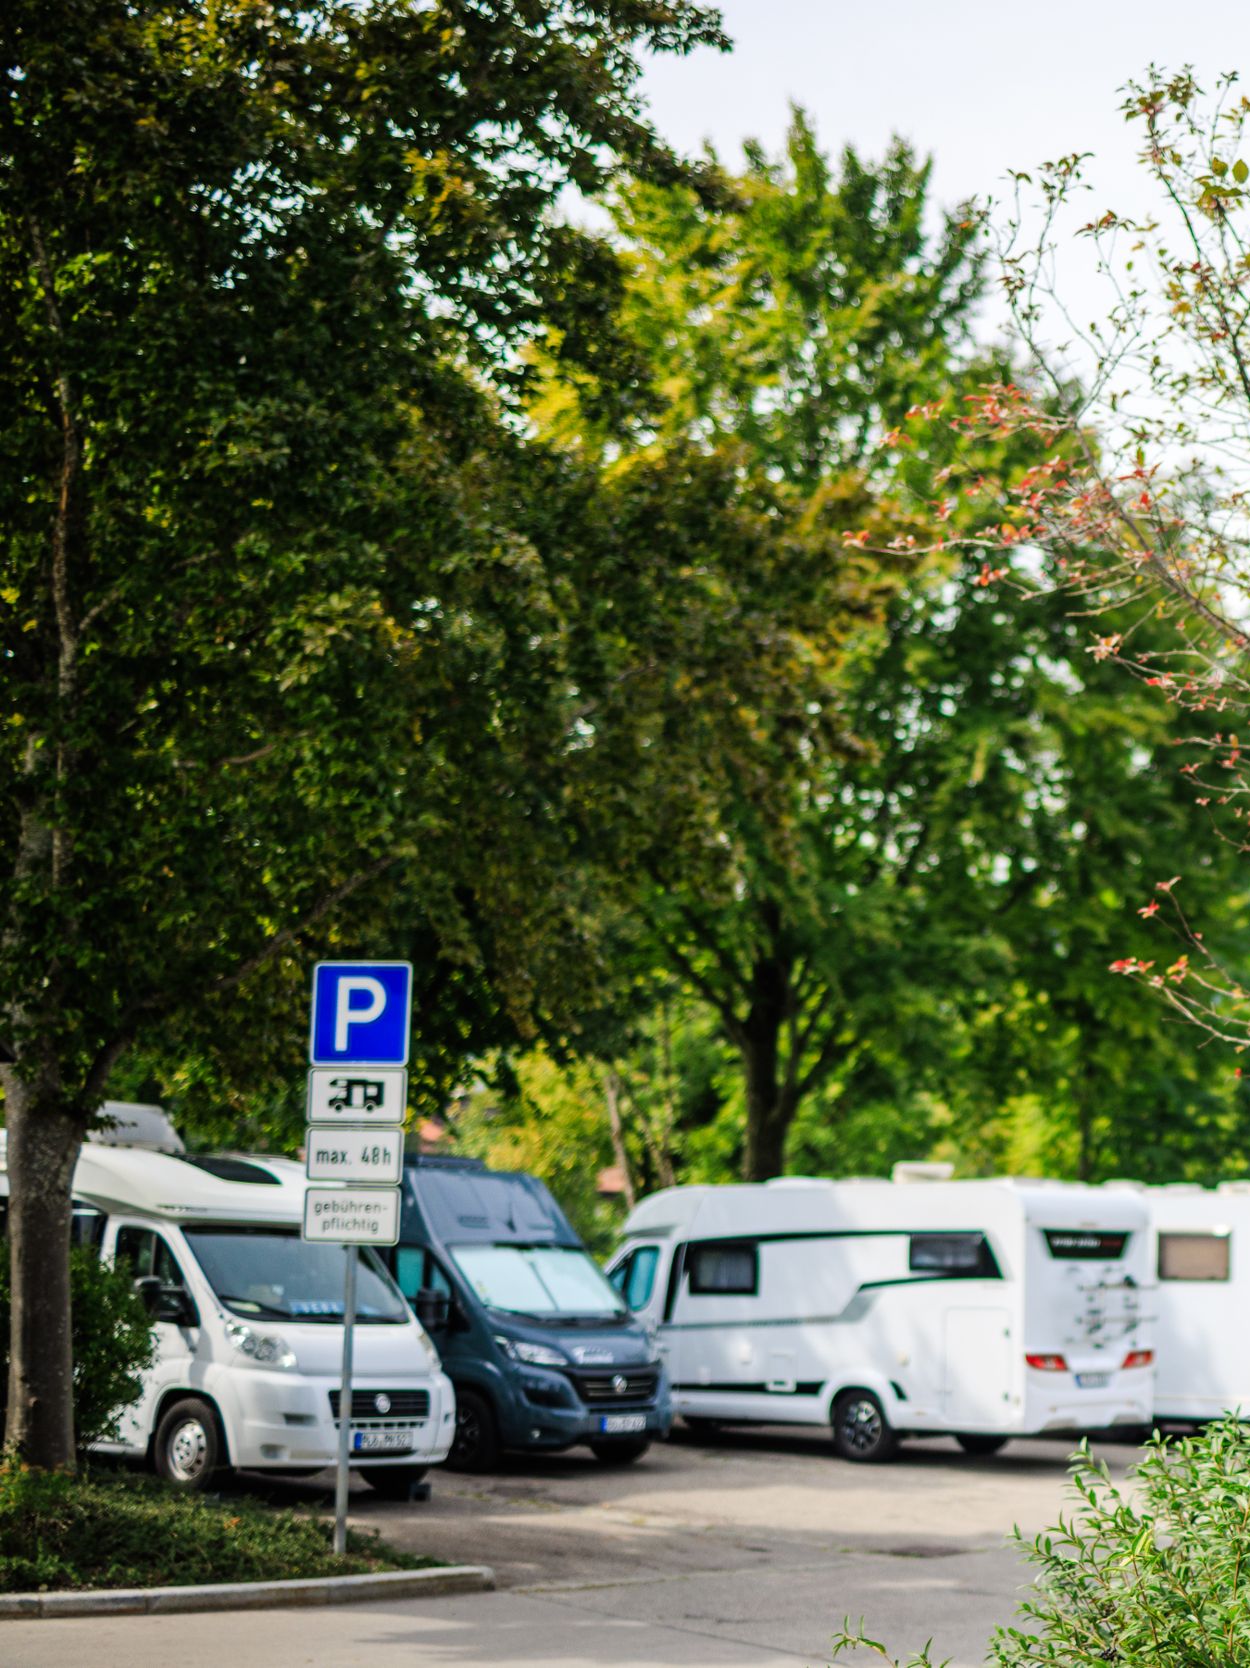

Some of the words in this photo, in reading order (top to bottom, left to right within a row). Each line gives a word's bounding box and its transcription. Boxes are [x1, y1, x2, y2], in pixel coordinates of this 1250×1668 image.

[334, 975, 387, 1052] P
[315, 1149, 352, 1165] max.
[360, 1146, 392, 1165] 48h
[313, 1200, 388, 1217] gebühren-
[321, 1216, 380, 1234] pflichtig
